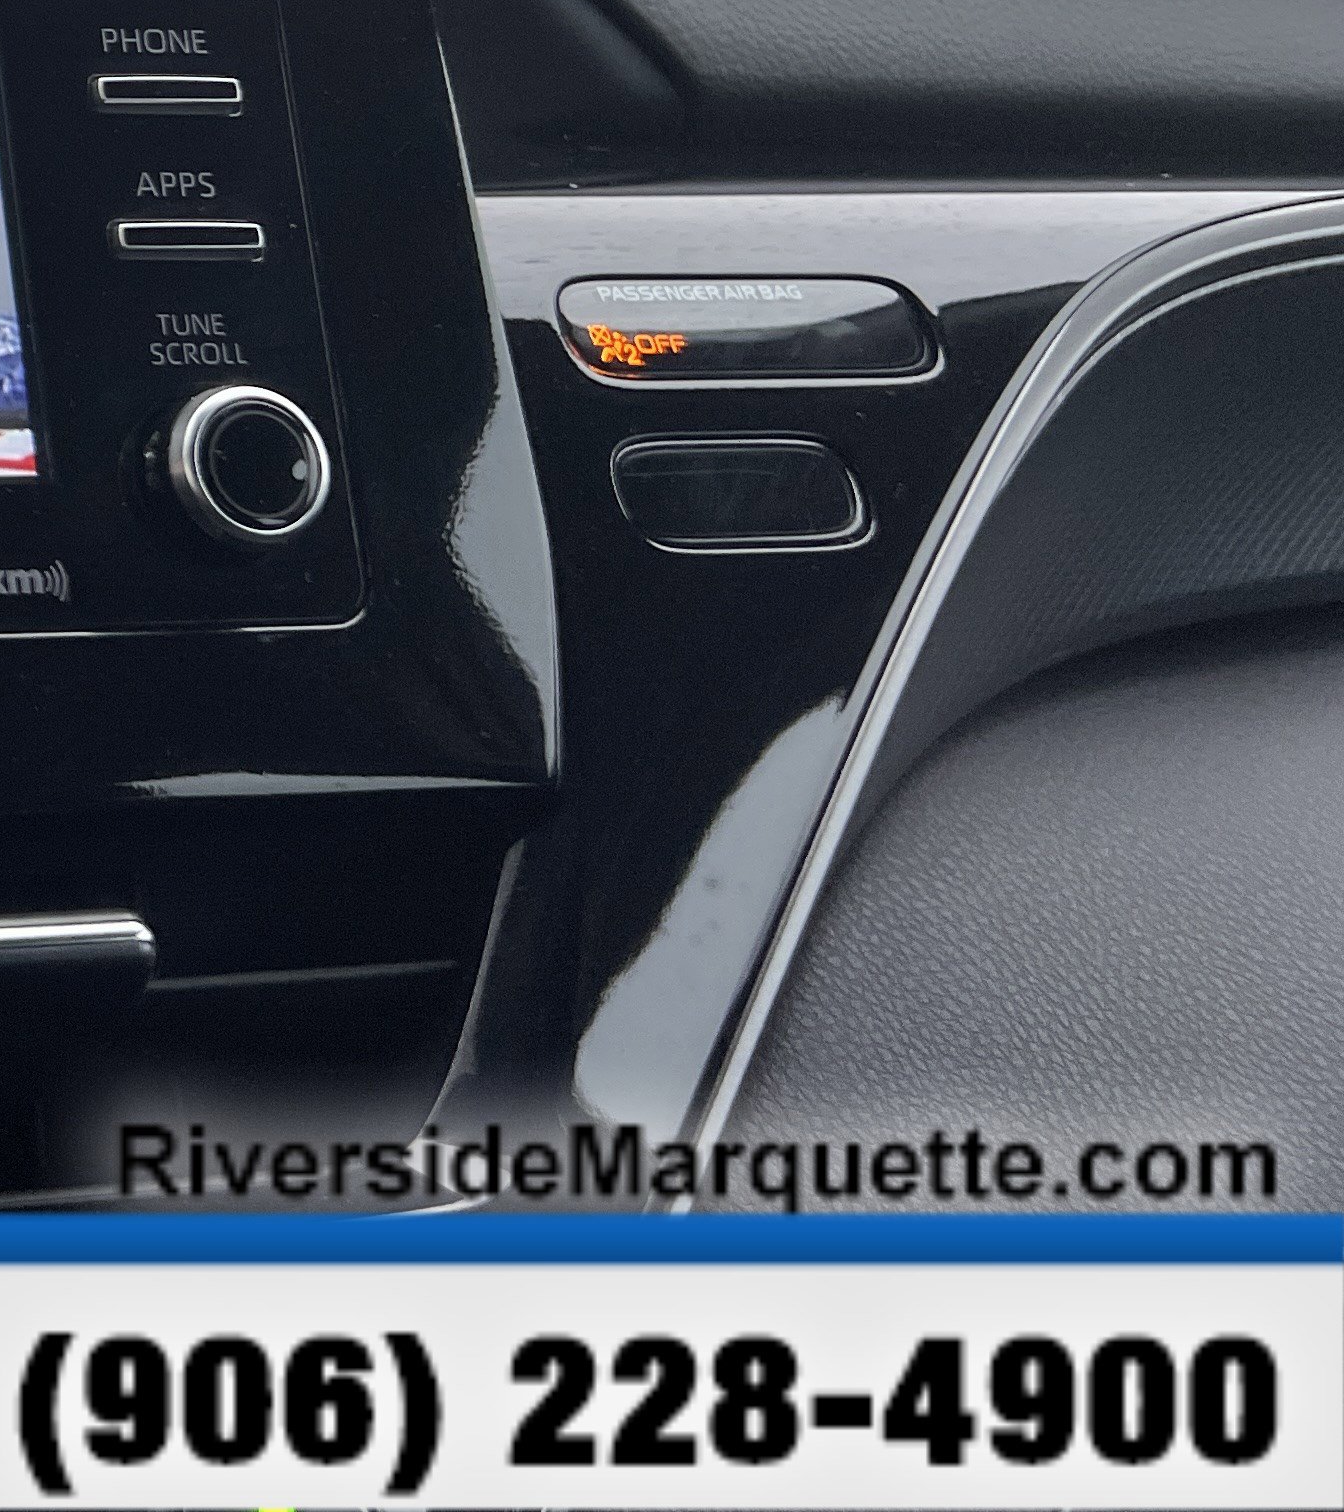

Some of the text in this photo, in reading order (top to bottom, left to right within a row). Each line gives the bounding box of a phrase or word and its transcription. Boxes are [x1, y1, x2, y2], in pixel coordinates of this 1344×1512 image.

[100, 27, 208, 55] PHONE
[136, 170, 217, 197] APPS
[595, 284, 803, 303] PASSENGER AIR BAG
[154, 312, 227, 336] TUNE
[149, 342, 249, 367] SCROLL
[633, 333, 687, 355] OFF
